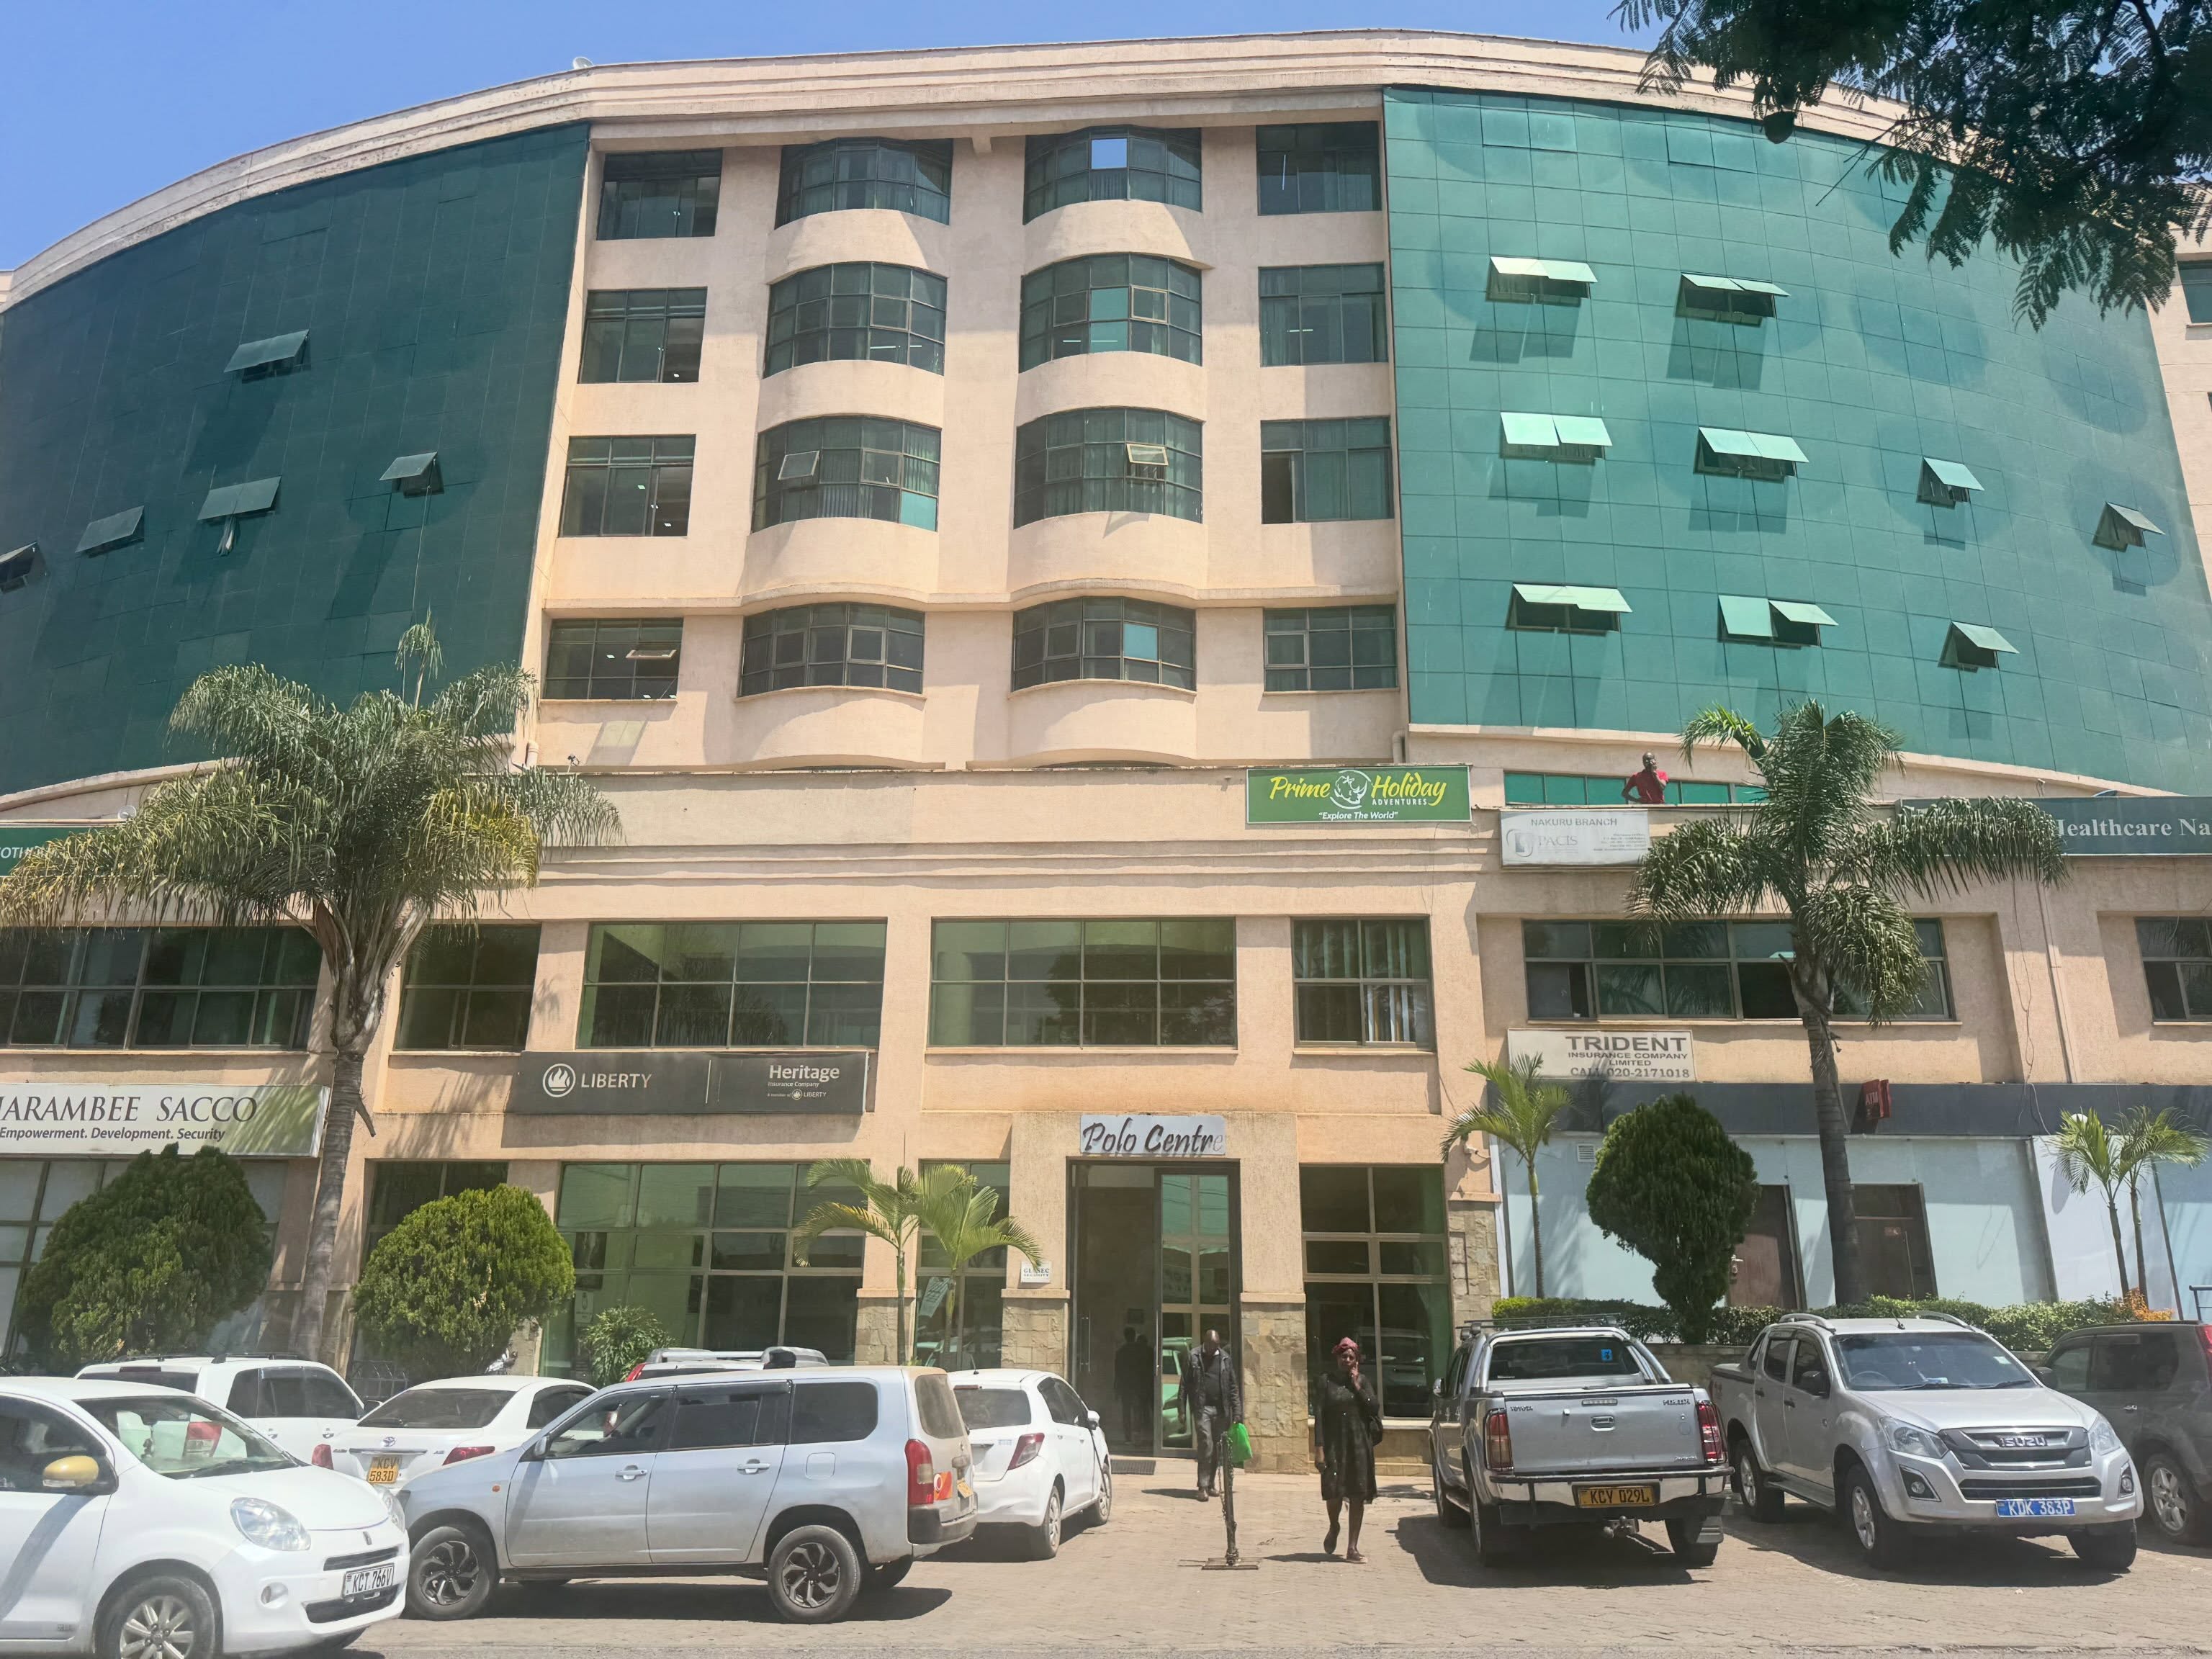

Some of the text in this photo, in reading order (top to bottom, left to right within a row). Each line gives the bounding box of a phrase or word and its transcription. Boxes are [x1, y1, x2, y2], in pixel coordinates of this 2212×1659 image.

[1269, 772, 1447, 806] Prime Holiday
[2177, 818, 2212, 837] Na
[1565, 1036, 1686, 1051] TRIDENT
[581, 1072, 652, 1089] LIBERTY
[769, 1065, 840, 1082] Heritage
[1606, 1068, 1690, 1078] 020-2171018
[156, 1097, 258, 1122] SACCO
[0, 1127, 225, 1142] Empowerment. Development. Security
[1082, 1117, 1137, 1152] Polo
[2000, 1437, 2047, 1447] ISUZU
[369, 1470, 394, 1482] 583D
[1590, 1488, 1650, 1503] KCY 029L
[2008, 1500, 2035, 1515] KDK
[352, 1568, 392, 1593] KCT 766V
